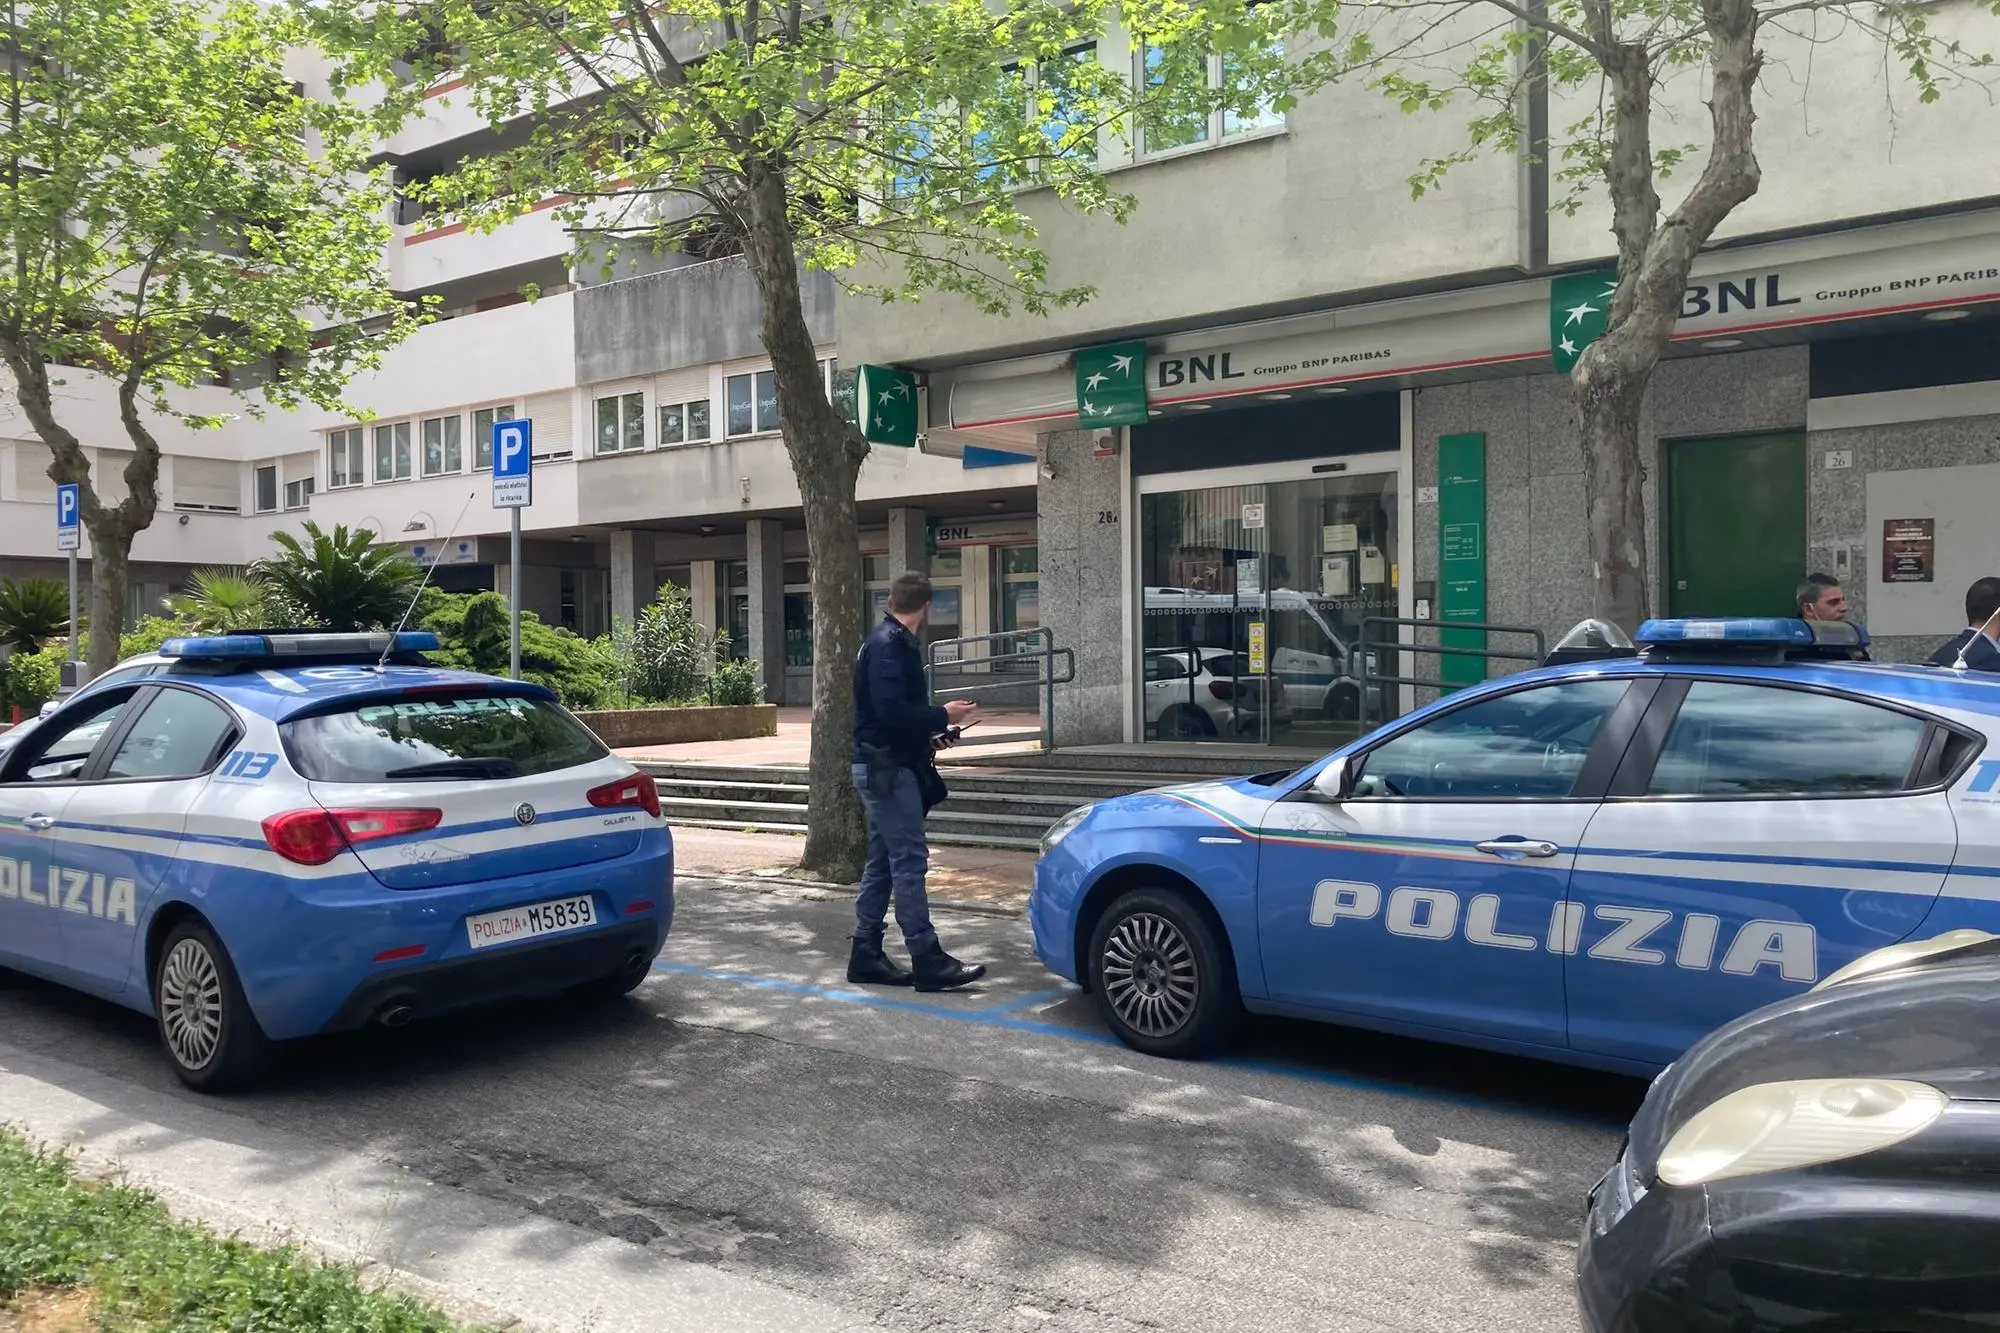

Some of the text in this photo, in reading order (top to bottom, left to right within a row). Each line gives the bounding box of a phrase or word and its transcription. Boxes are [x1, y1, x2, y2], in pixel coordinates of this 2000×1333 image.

[1678, 273, 1801, 319] BNL
[1815, 286, 1882, 300] Gruppo
[1890, 277, 1931, 290] BNP
[1159, 349, 1391, 388] BNL Gruppo BNP PARIBAS
[501, 427, 523, 472] P
[61, 490, 75, 523] P
[940, 526, 975, 541] BNL
[357, 696, 537, 723] POLIZIA
[219, 750, 280, 780] 113
[473, 899, 592, 941] POLIZIA M5839
[1309, 877, 1818, 984] POLIZIA
